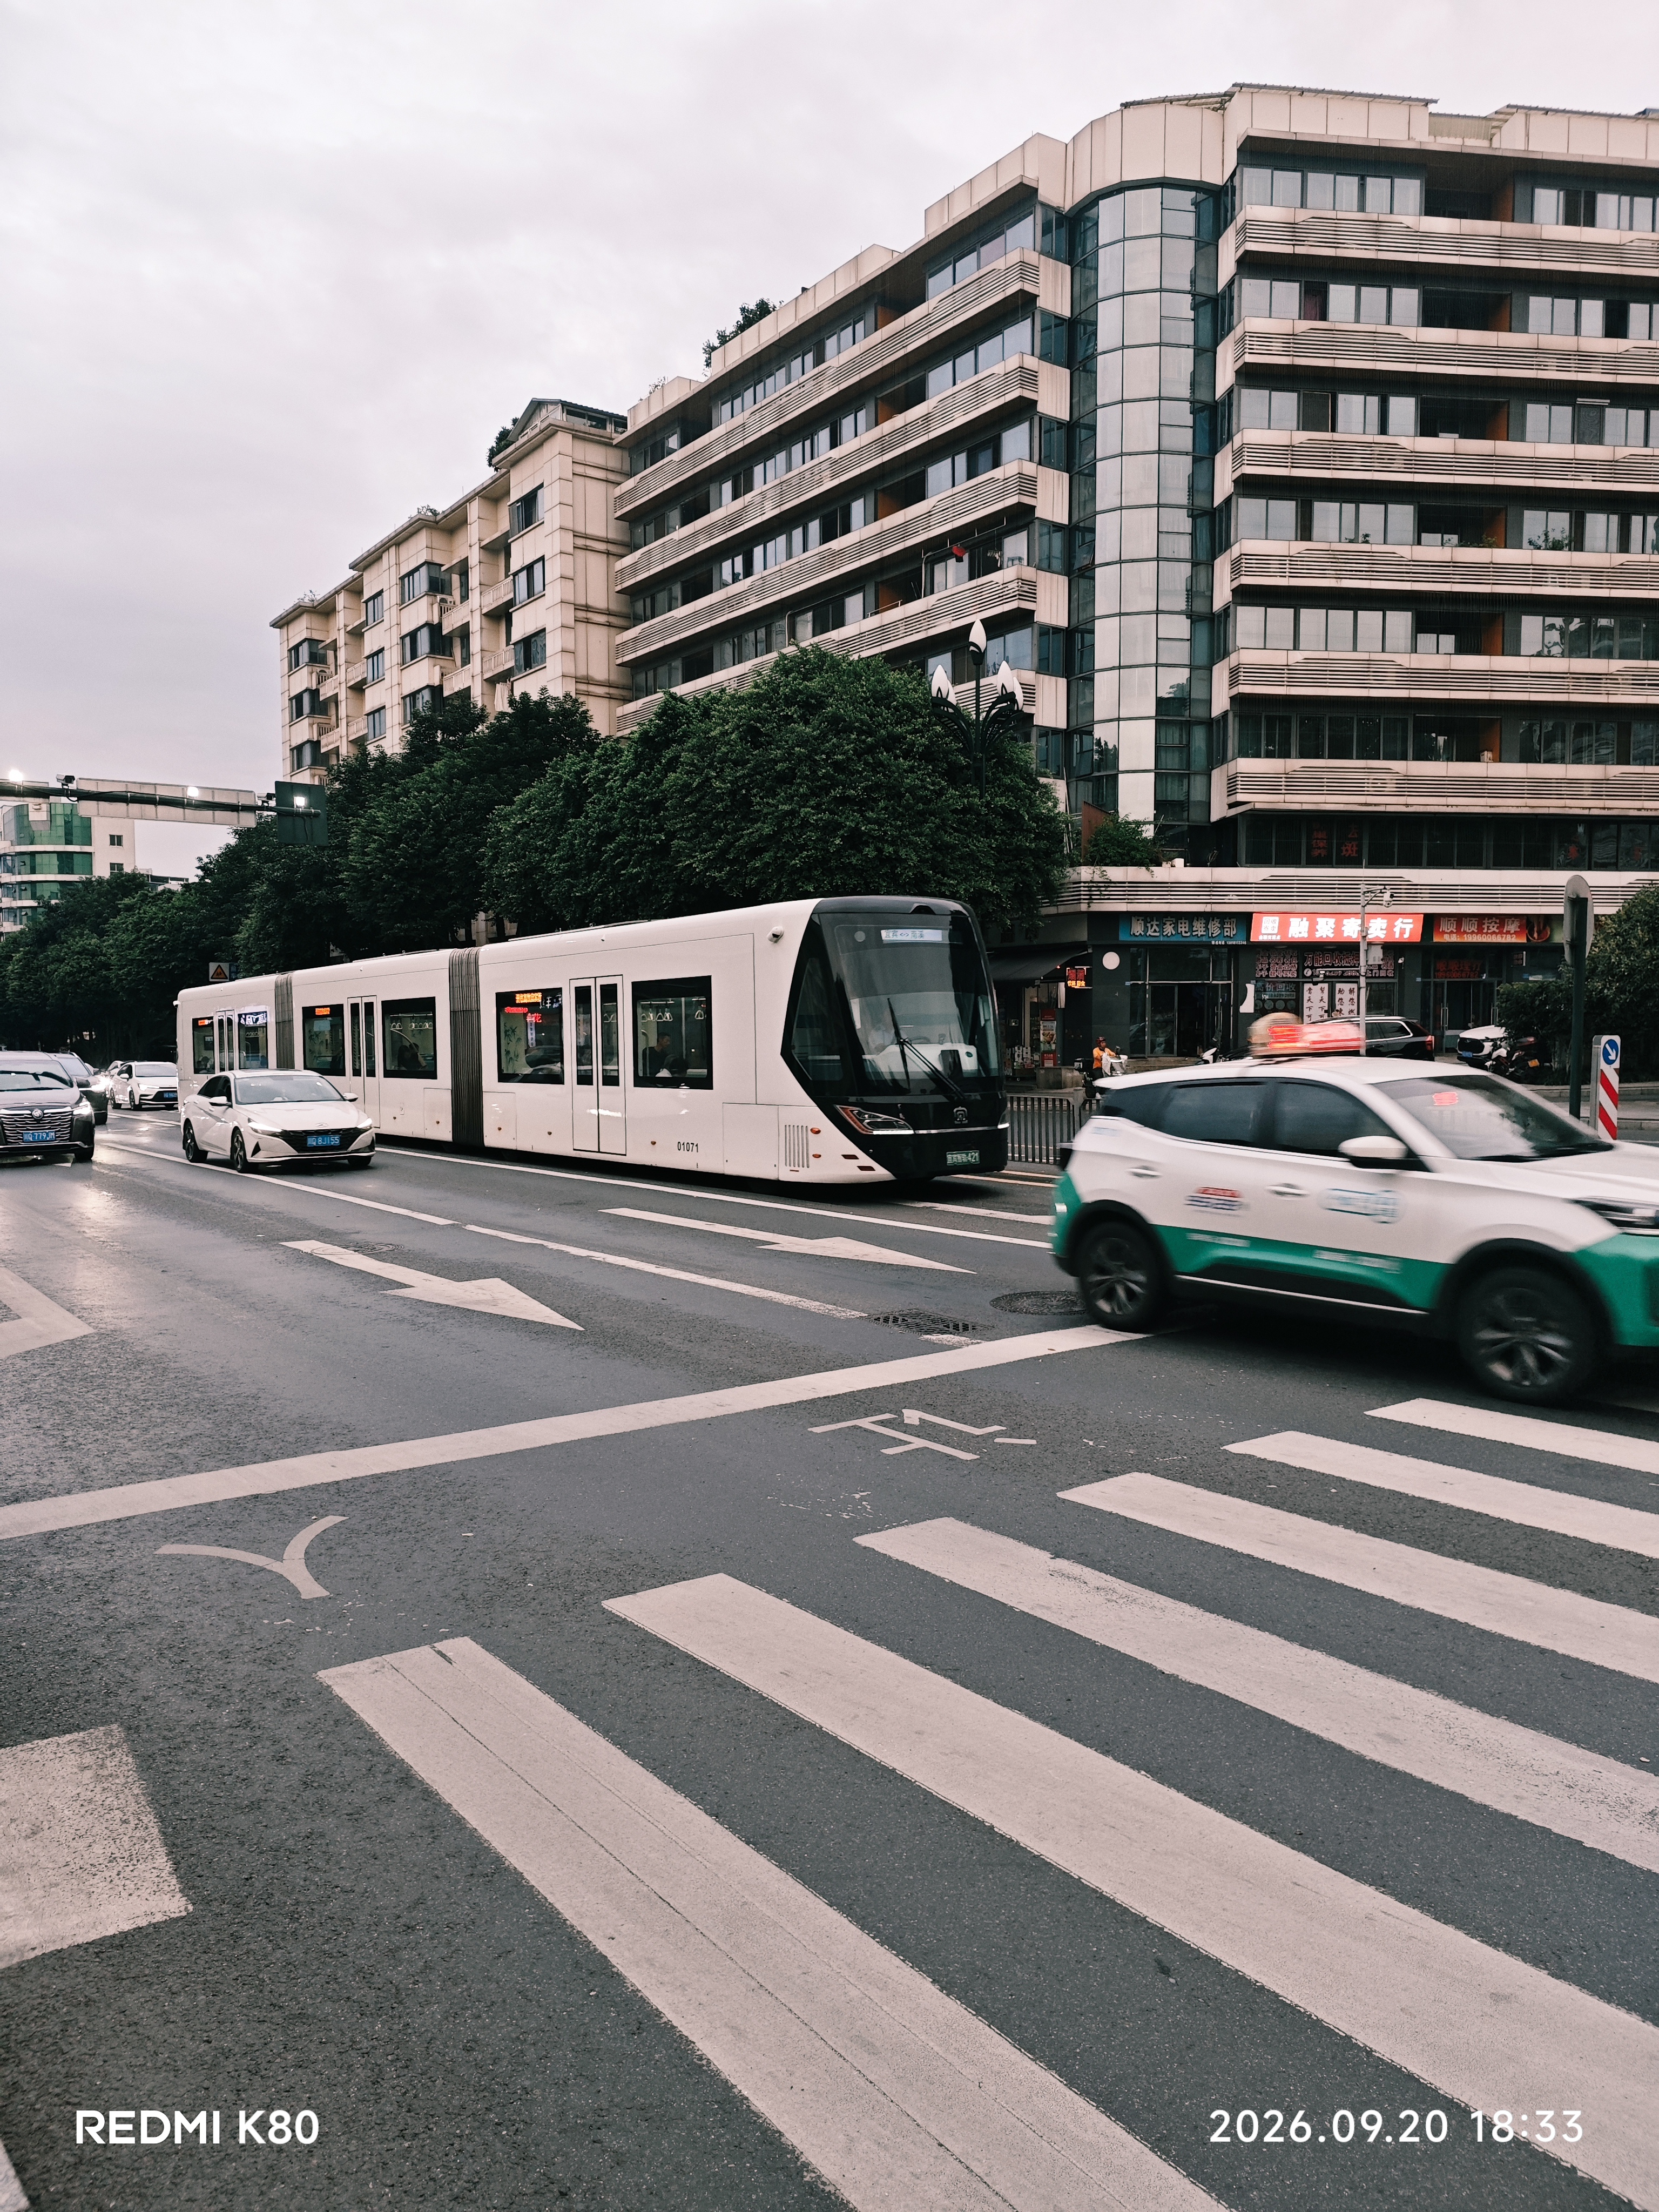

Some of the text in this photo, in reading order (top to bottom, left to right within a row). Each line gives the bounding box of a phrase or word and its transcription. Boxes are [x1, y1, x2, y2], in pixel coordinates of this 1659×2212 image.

[1130, 916, 1236, 938] 顺达家电维修部
[1288, 918, 1413, 939] 融聚寄卖行
[1440, 917, 1520, 933] 顺顺按摩
[1304, 952, 1360, 967] 万能回收抵押
[677, 1141, 699, 1153] 01071
